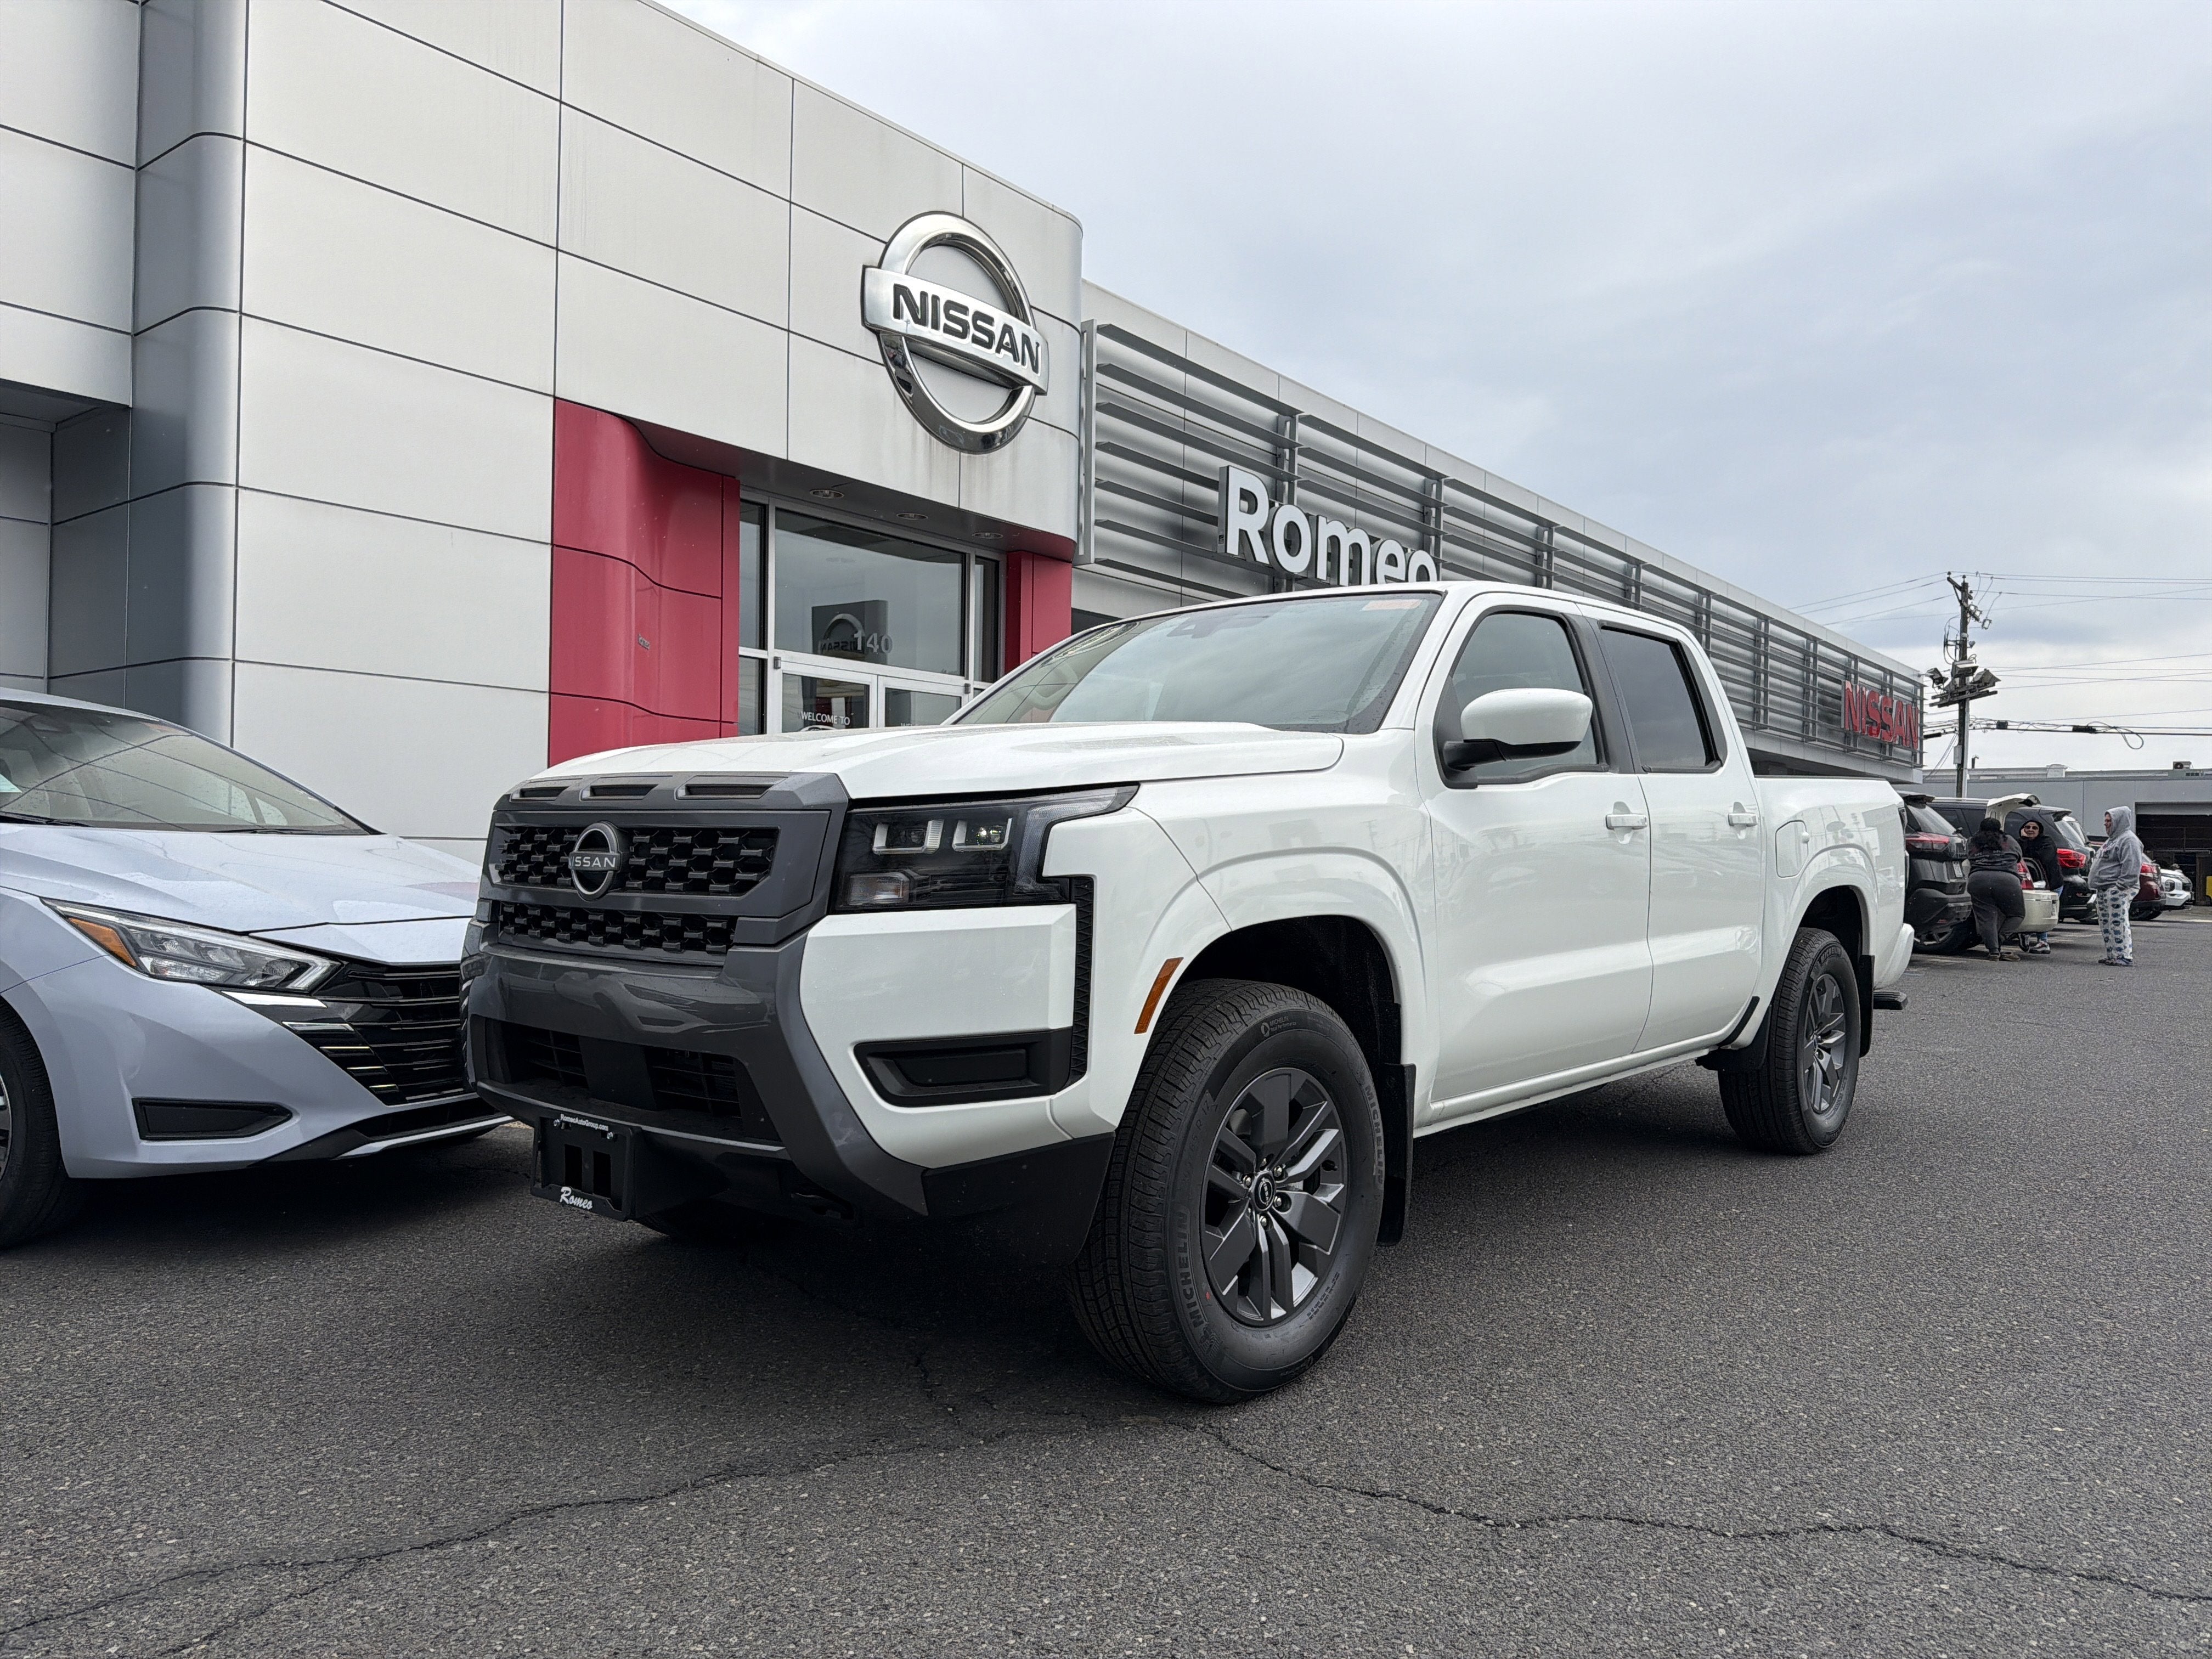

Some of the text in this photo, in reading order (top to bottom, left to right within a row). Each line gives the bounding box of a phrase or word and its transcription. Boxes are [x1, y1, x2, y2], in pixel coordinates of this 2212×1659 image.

[893, 283, 1040, 375] NISSAN
[1220, 465, 1438, 586] Romeo
[854, 630, 893, 654] 140
[801, 711, 851, 726] WELCOME TO
[1843, 680, 1919, 750] NISSAN
[560, 1113, 609, 1131] RomeoAutoGroup.com
[560, 1186, 593, 1210] Romeo
[1177, 1211, 1204, 1328] MICHELIN
